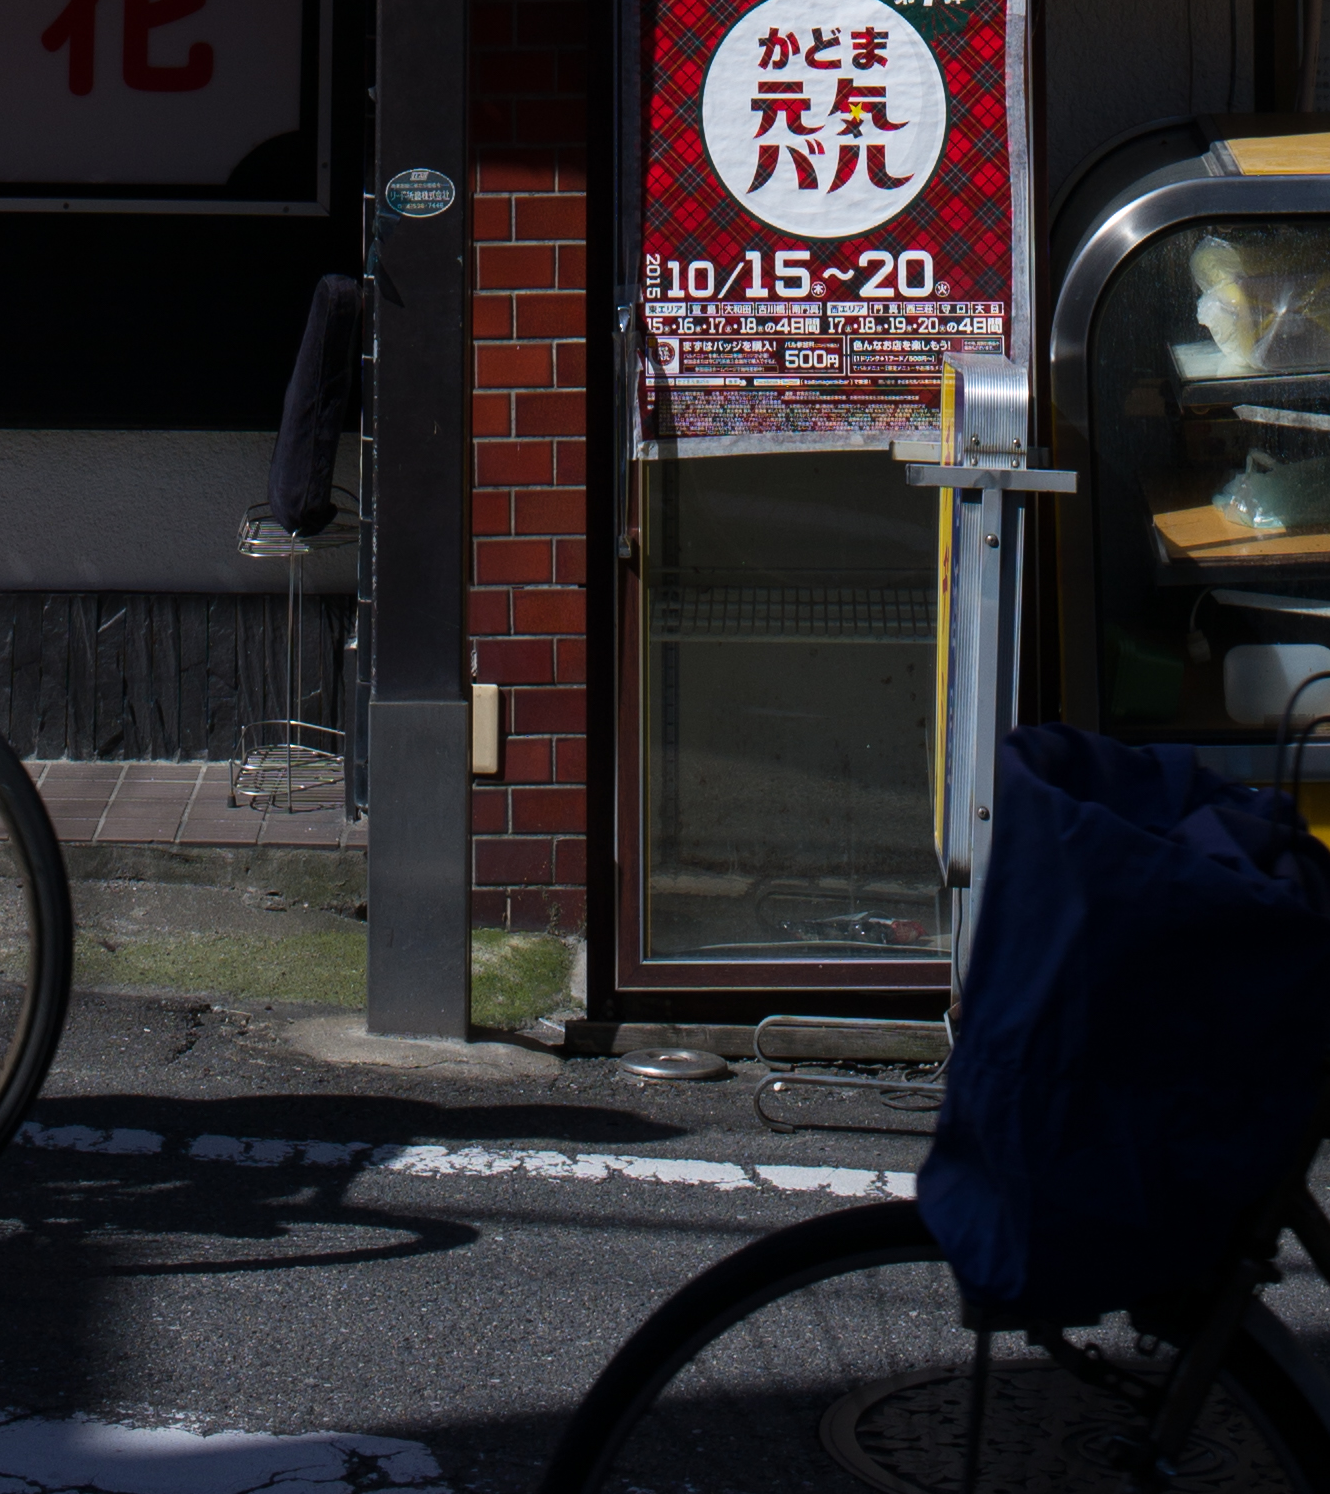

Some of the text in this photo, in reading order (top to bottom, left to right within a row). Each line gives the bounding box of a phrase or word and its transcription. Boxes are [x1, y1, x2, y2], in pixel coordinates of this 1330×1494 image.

[758, 26, 889, 70] かどま
[751, 78, 910, 139] 元気
[747, 138, 915, 195] バル
[646, 253, 661, 299] 2015
[648, 304, 683, 314] 東エリア
[724, 304, 752, 314] 大和田
[974, 304, 1000, 314] 大日
[784, 350, 839, 368] 500円
